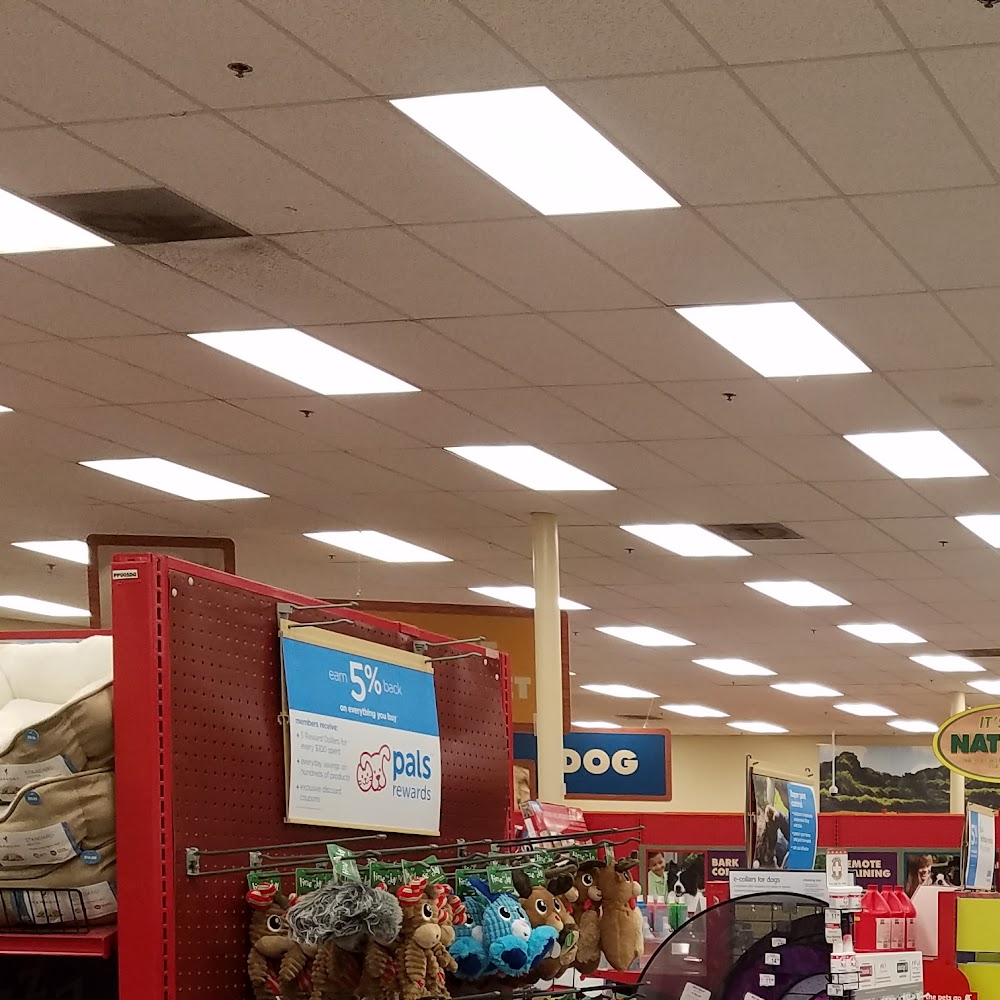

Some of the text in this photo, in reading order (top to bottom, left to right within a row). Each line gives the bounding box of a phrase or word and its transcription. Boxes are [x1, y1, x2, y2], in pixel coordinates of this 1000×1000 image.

[328, 661, 403, 702] earn 5% back
[340, 704, 397, 723] on everything you buy
[295, 718, 319, 728] members
[392, 750, 432, 781] pals
[563, 748, 639, 775] DOG
[392, 784, 432, 801] rewards
[711, 858, 739, 867] BARK
[847, 860, 882, 868] EMOTE
[711, 868, 730, 876] CO
[733, 875, 781, 885] e-collars for dogs
